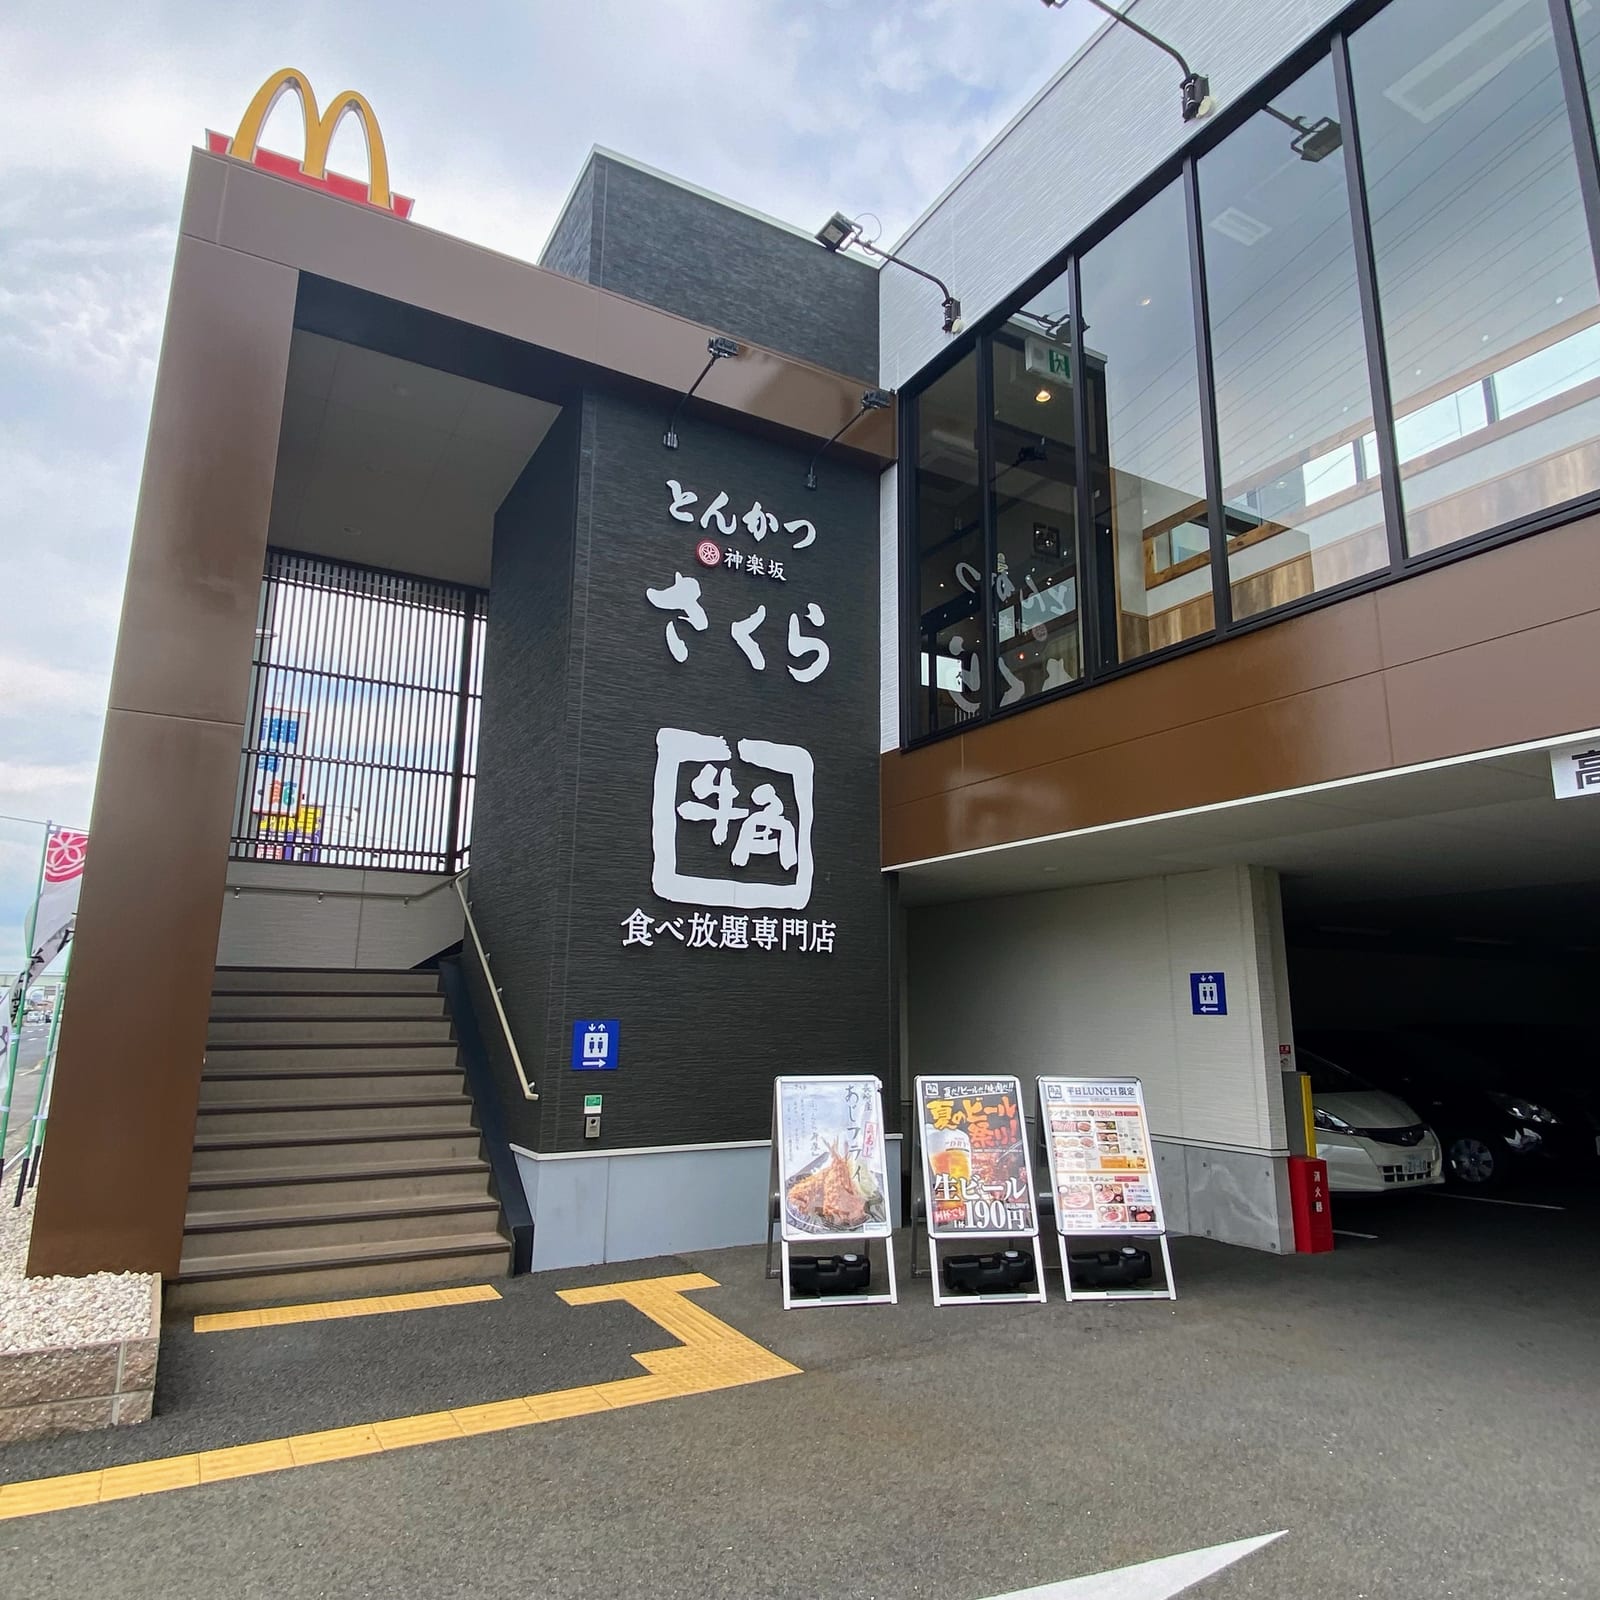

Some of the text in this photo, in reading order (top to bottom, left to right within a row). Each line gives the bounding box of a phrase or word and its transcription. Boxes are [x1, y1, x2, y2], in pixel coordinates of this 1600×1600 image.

[666, 480, 816, 549] とんかつ
[723, 548, 787, 581] 神楽坂
[646, 572, 829, 683] さくら
[677, 763, 798, 870] 牛角
[621, 908, 836, 953] 食べ放題専門店
[845, 1085, 862, 1182] あじフライ
[927, 1096, 1016, 1130] 夏のビール
[934, 1173, 1026, 1200] 生ビール
